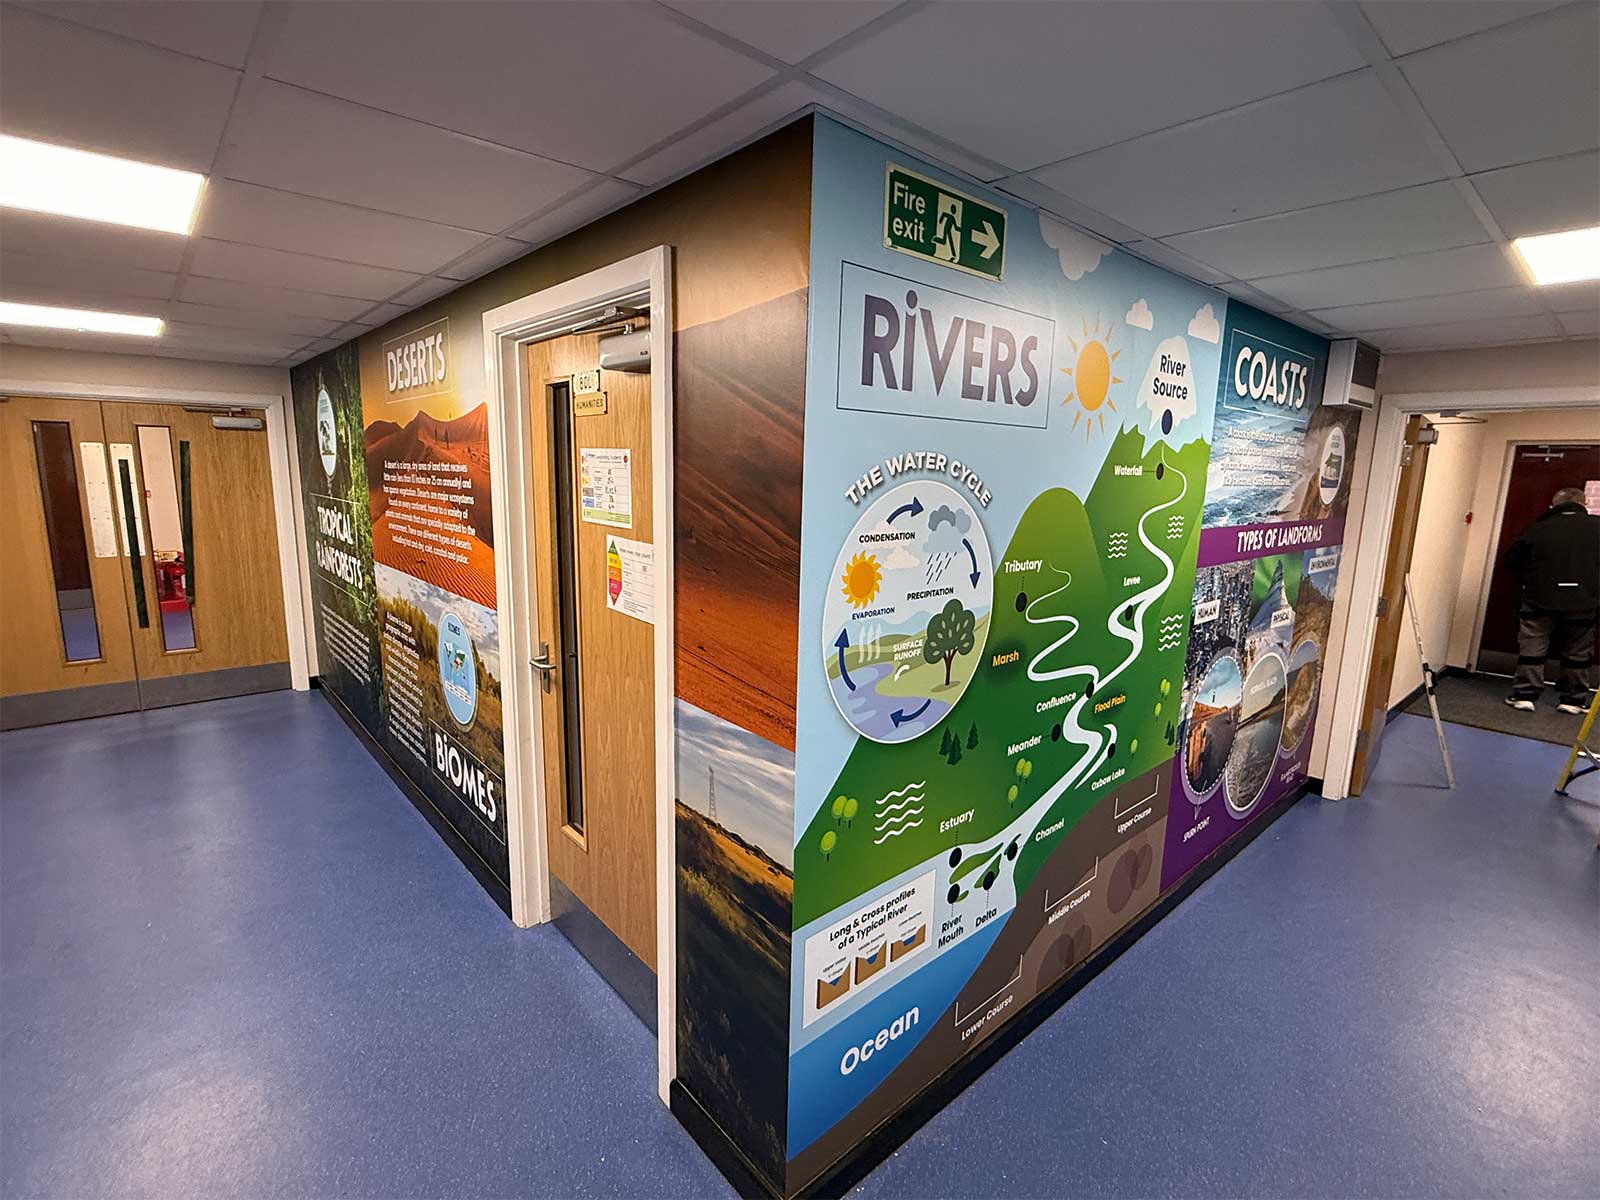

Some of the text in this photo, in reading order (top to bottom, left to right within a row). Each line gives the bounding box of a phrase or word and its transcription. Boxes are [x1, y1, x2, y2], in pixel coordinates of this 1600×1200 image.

[893, 181, 926, 215] Fire
[892, 219, 925, 243] exit
[387, 332, 445, 392] DESERTS
[1160, 355, 1186, 378] River
[1234, 346, 1307, 409] COASTS
[1153, 378, 1188, 402] Source
[576, 398, 604, 409] HUMANITIES
[845, 452, 993, 508] THE WATER CYCLE
[1114, 465, 1143, 476] Waterfall
[463, 479, 472, 488] and
[859, 532, 916, 544] CONDENSATION
[1237, 524, 1323, 554] TYPES OF LANDFORMS
[1004, 559, 1043, 574] Tributary
[1123, 576, 1141, 587] Levee
[907, 587, 954, 601] PRECIPITATION
[852, 607, 896, 621] EVAPORATION
[893, 638, 924, 652] SURFACE
[894, 649, 922, 662] RUNOFF
[992, 650, 1020, 666] Marsh
[1036, 692, 1077, 714] Confluence
[1094, 694, 1126, 714] Flood Plain
[1007, 735, 1042, 757] Meander
[1111, 767, 1126, 781] Lake
[939, 808, 975, 833] Estuary
[1035, 818, 1065, 842] Channel
[1117, 807, 1152, 834] Upper Course
[829, 921, 852, 942] Long
[852, 918, 861, 929] &
[861, 905, 886, 924] Cross
[886, 887, 916, 914] profiles
[975, 906, 998, 928] Delta
[1047, 889, 1092, 925] Middle Course
[838, 937, 849, 951] of
[848, 935, 856, 947] a
[856, 914, 887, 940] Typical
[887, 903, 909, 922] River
[941, 914, 963, 935] River
[938, 926, 965, 949] Mouth
[961, 994, 1014, 1041] Lower Course
[840, 1006, 919, 1077] Ocean
